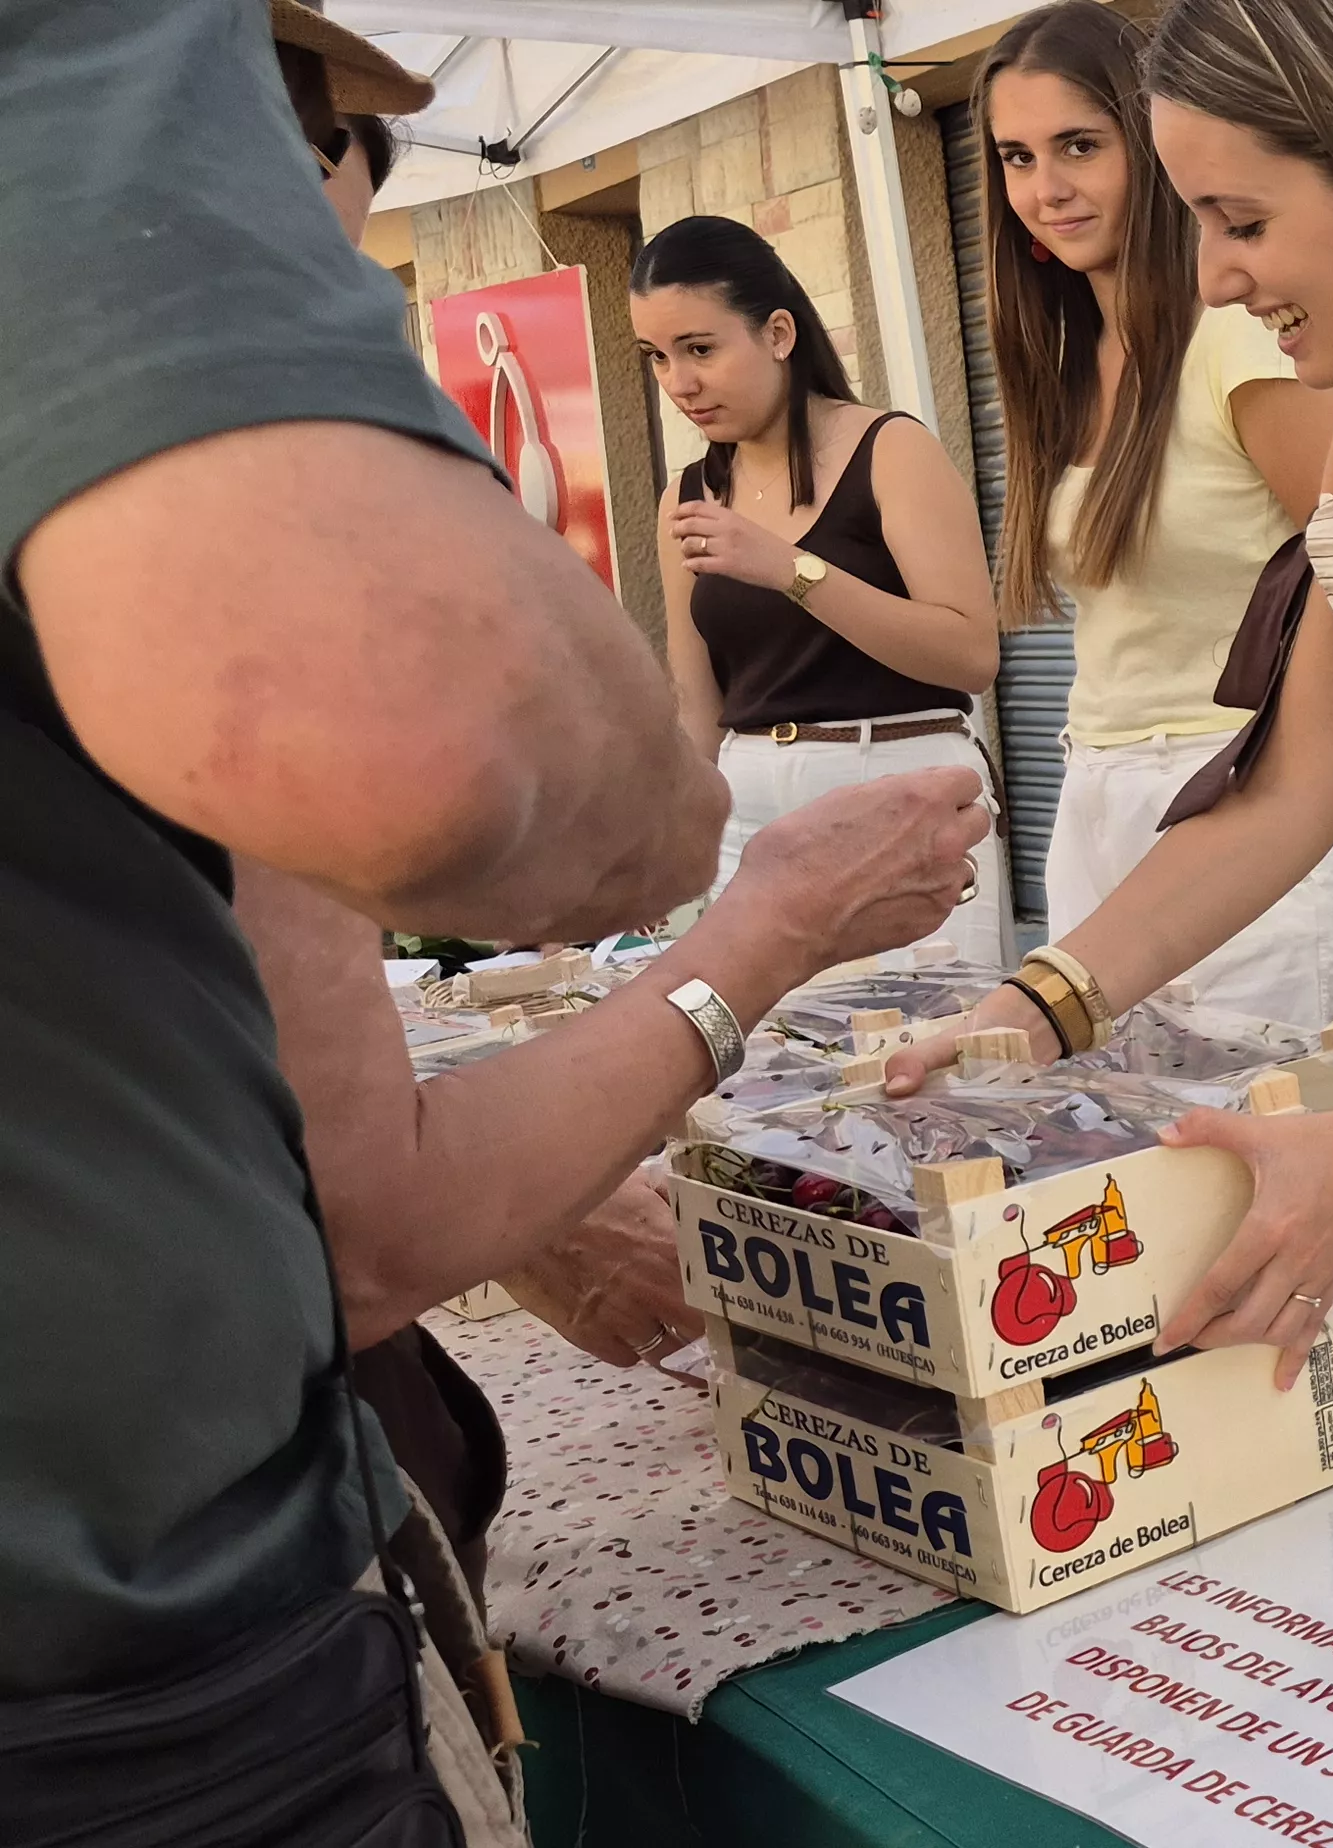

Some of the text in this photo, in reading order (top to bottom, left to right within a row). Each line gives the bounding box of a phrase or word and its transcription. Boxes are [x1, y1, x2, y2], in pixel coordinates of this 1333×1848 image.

[717, 1197, 890, 1266] CEREZAS DE
[699, 1218, 931, 1349] BOLEA
[737, 1295, 755, 1312] 638
[756, 1302, 774, 1319] 114
[776, 1308, 794, 1325] 438
[811, 1320, 828, 1336] 60
[830, 1327, 849, 1343] 663
[851, 1334, 871, 1351] 934
[876, 1342, 935, 1376] (HUESCA)
[1000, 1313, 1155, 1380] Cereza de Bolea
[760, 1399, 932, 1476] CEREZAS DE
[741, 1417, 972, 1557] BOLEA
[779, 1494, 797, 1511] 638
[799, 1502, 817, 1520] 114
[818, 1509, 837, 1527] 438
[872, 1531, 890, 1548] 663
[892, 1539, 912, 1557] 934
[918, 1549, 977, 1584] (HUESCA)
[1039, 1514, 1190, 1587] Cereza de Bolea
[1157, 1570, 1221, 1596] LES
[1130, 1614, 1239, 1660] BAJOS
[1223, 1651, 1295, 1687] DEL
[1065, 1646, 1235, 1721] DISPONEN
[1216, 1711, 1283, 1742] DE
[1005, 1690, 1070, 1722] DE
[1052, 1712, 1196, 1781] GUARDA
[1181, 1769, 1251, 1804] DE
